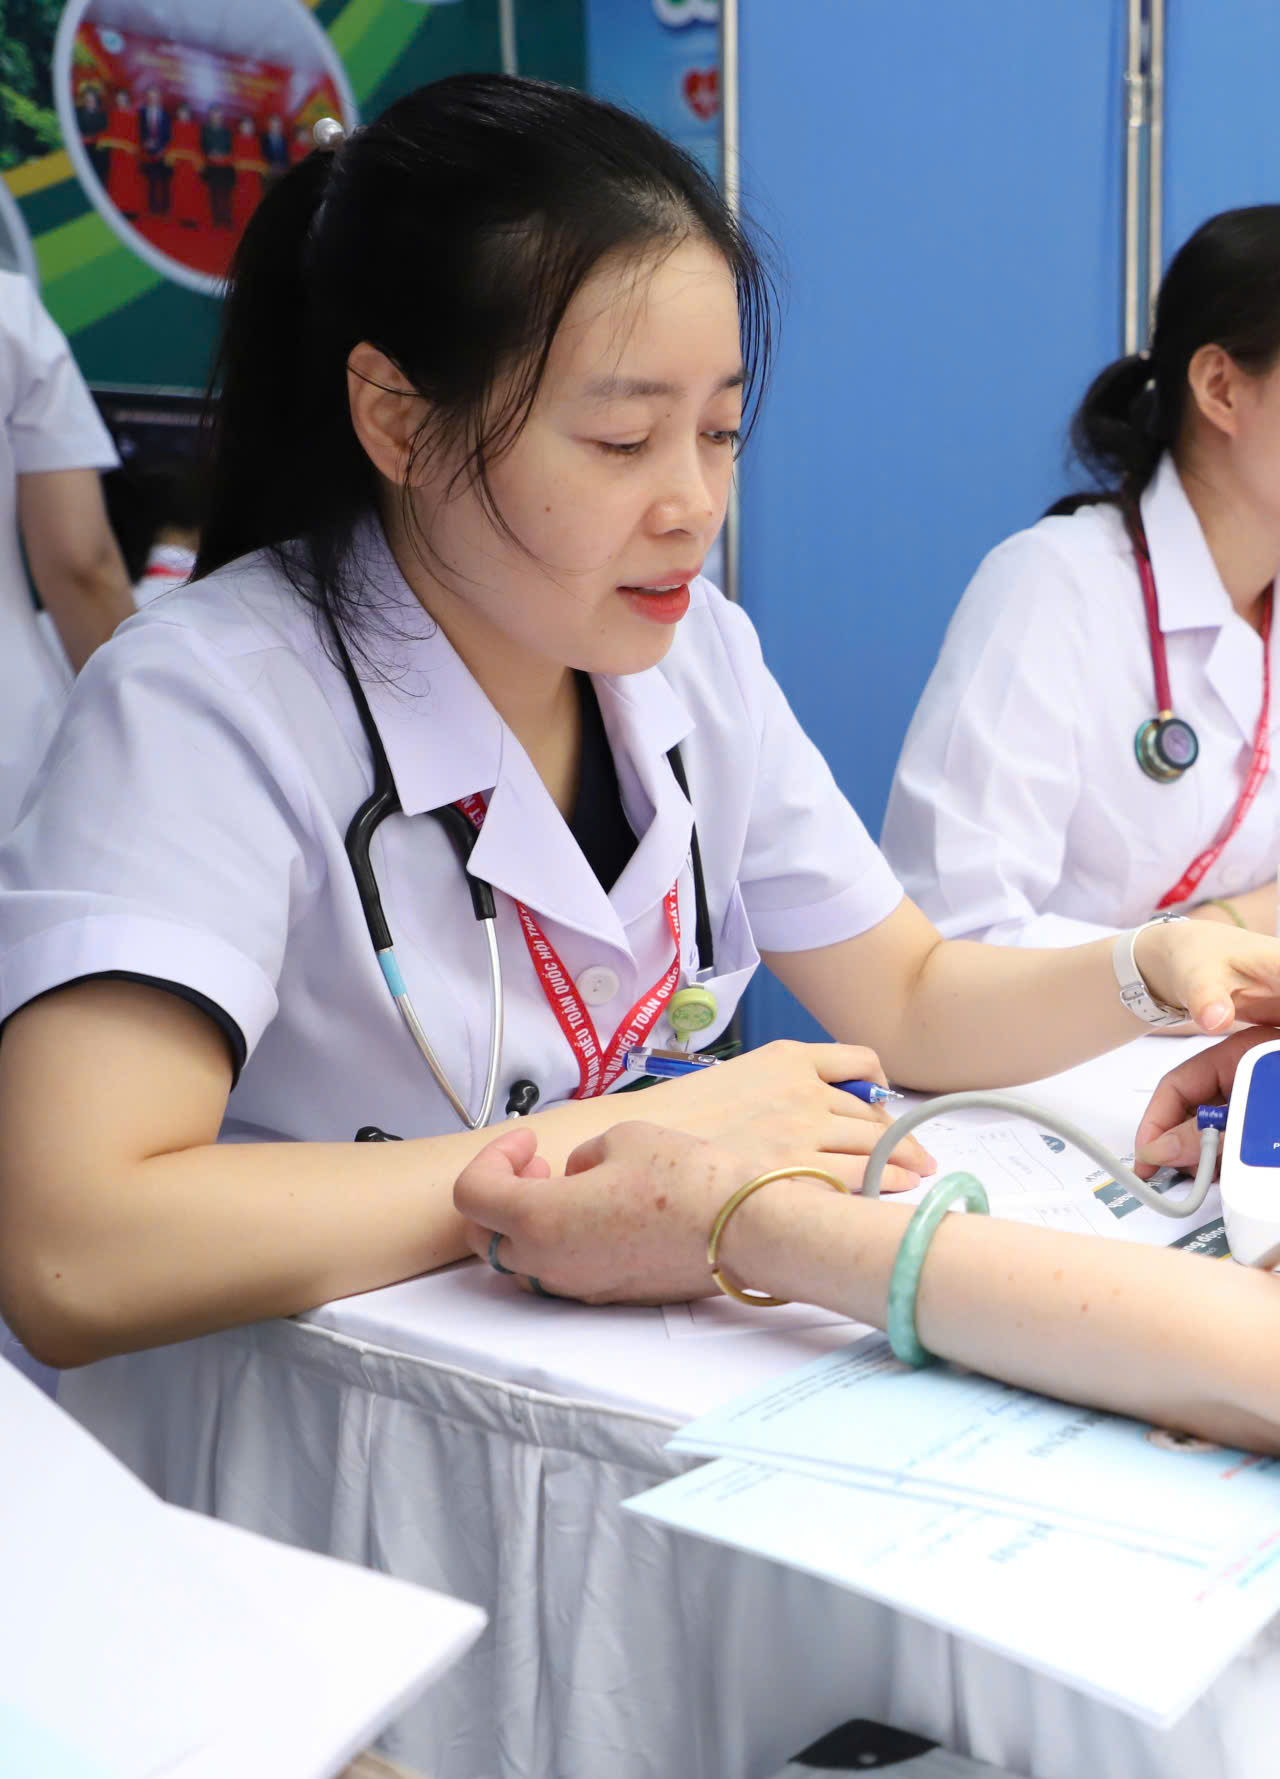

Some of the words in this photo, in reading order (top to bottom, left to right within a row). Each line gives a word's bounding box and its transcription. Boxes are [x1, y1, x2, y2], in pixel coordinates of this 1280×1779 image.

[533, 940, 553, 960] HỘI
[541, 962, 570, 994] QUỐC
[560, 995, 584, 1029] TOÀN
[631, 996, 661, 1030] TOÀN
[657, 967, 679, 999] QUỐC
[574, 1028, 596, 1058] BIỂU
